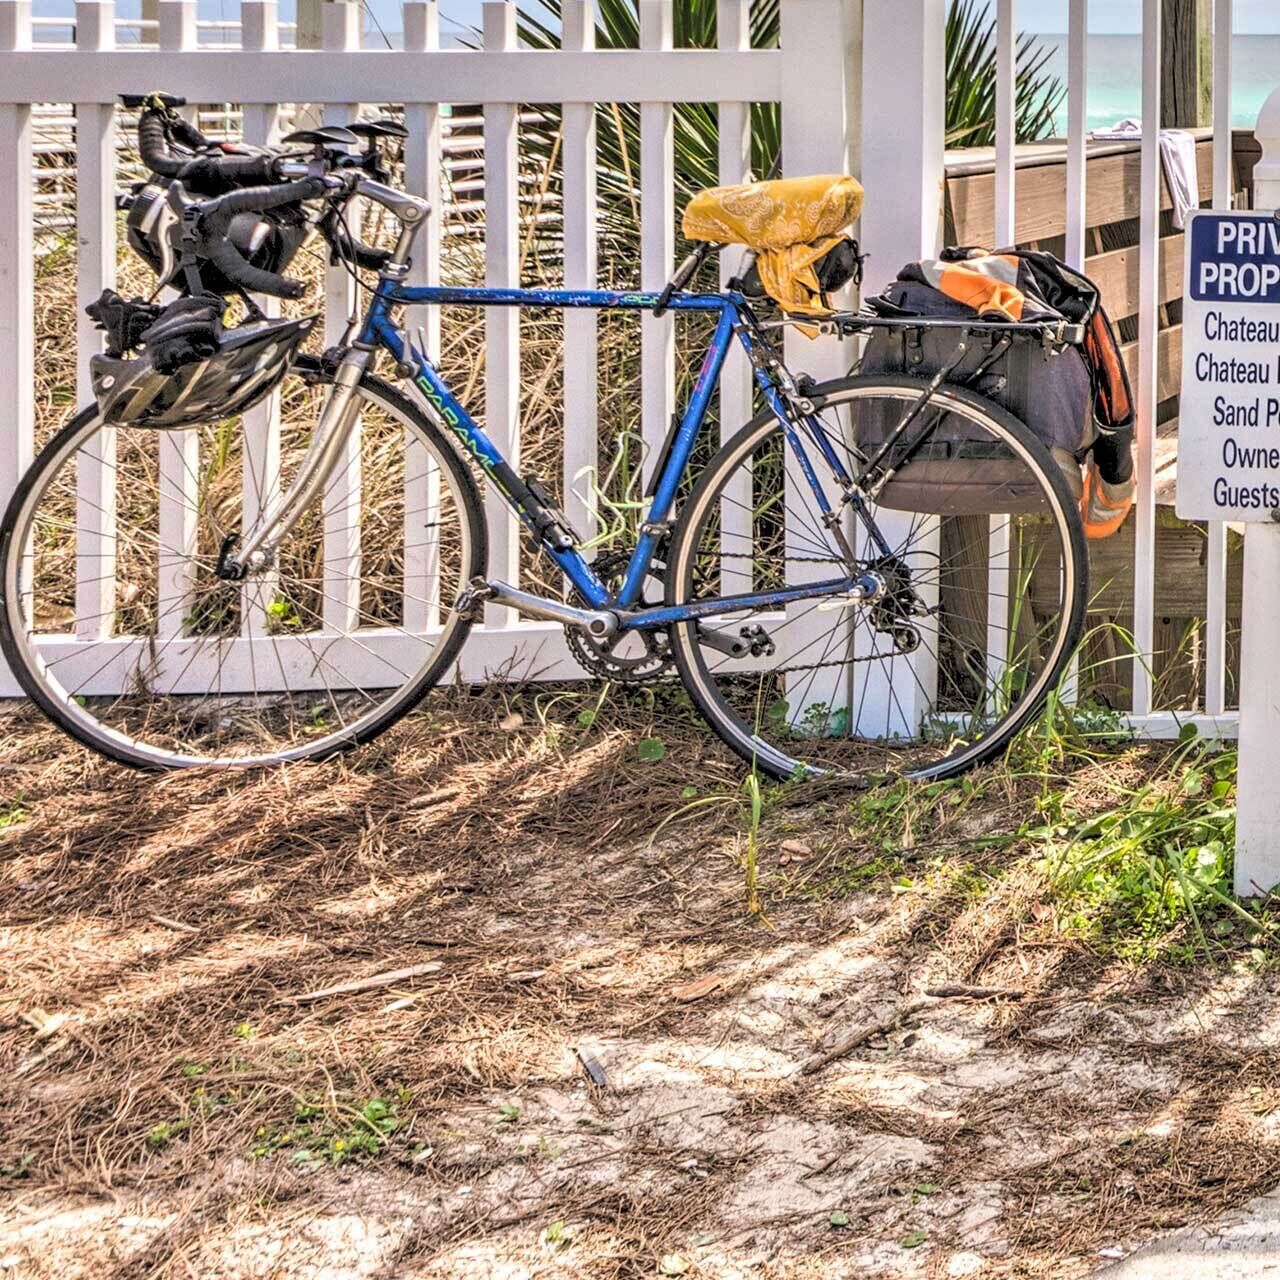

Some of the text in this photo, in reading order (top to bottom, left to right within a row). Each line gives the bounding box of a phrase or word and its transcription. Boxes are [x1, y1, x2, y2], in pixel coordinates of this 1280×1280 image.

[1204, 311, 1279, 343] Chateau
[1195, 352, 1270, 384] Chateau
[1213, 395, 1259, 427] Sand
[1213, 477, 1280, 509] Guests
